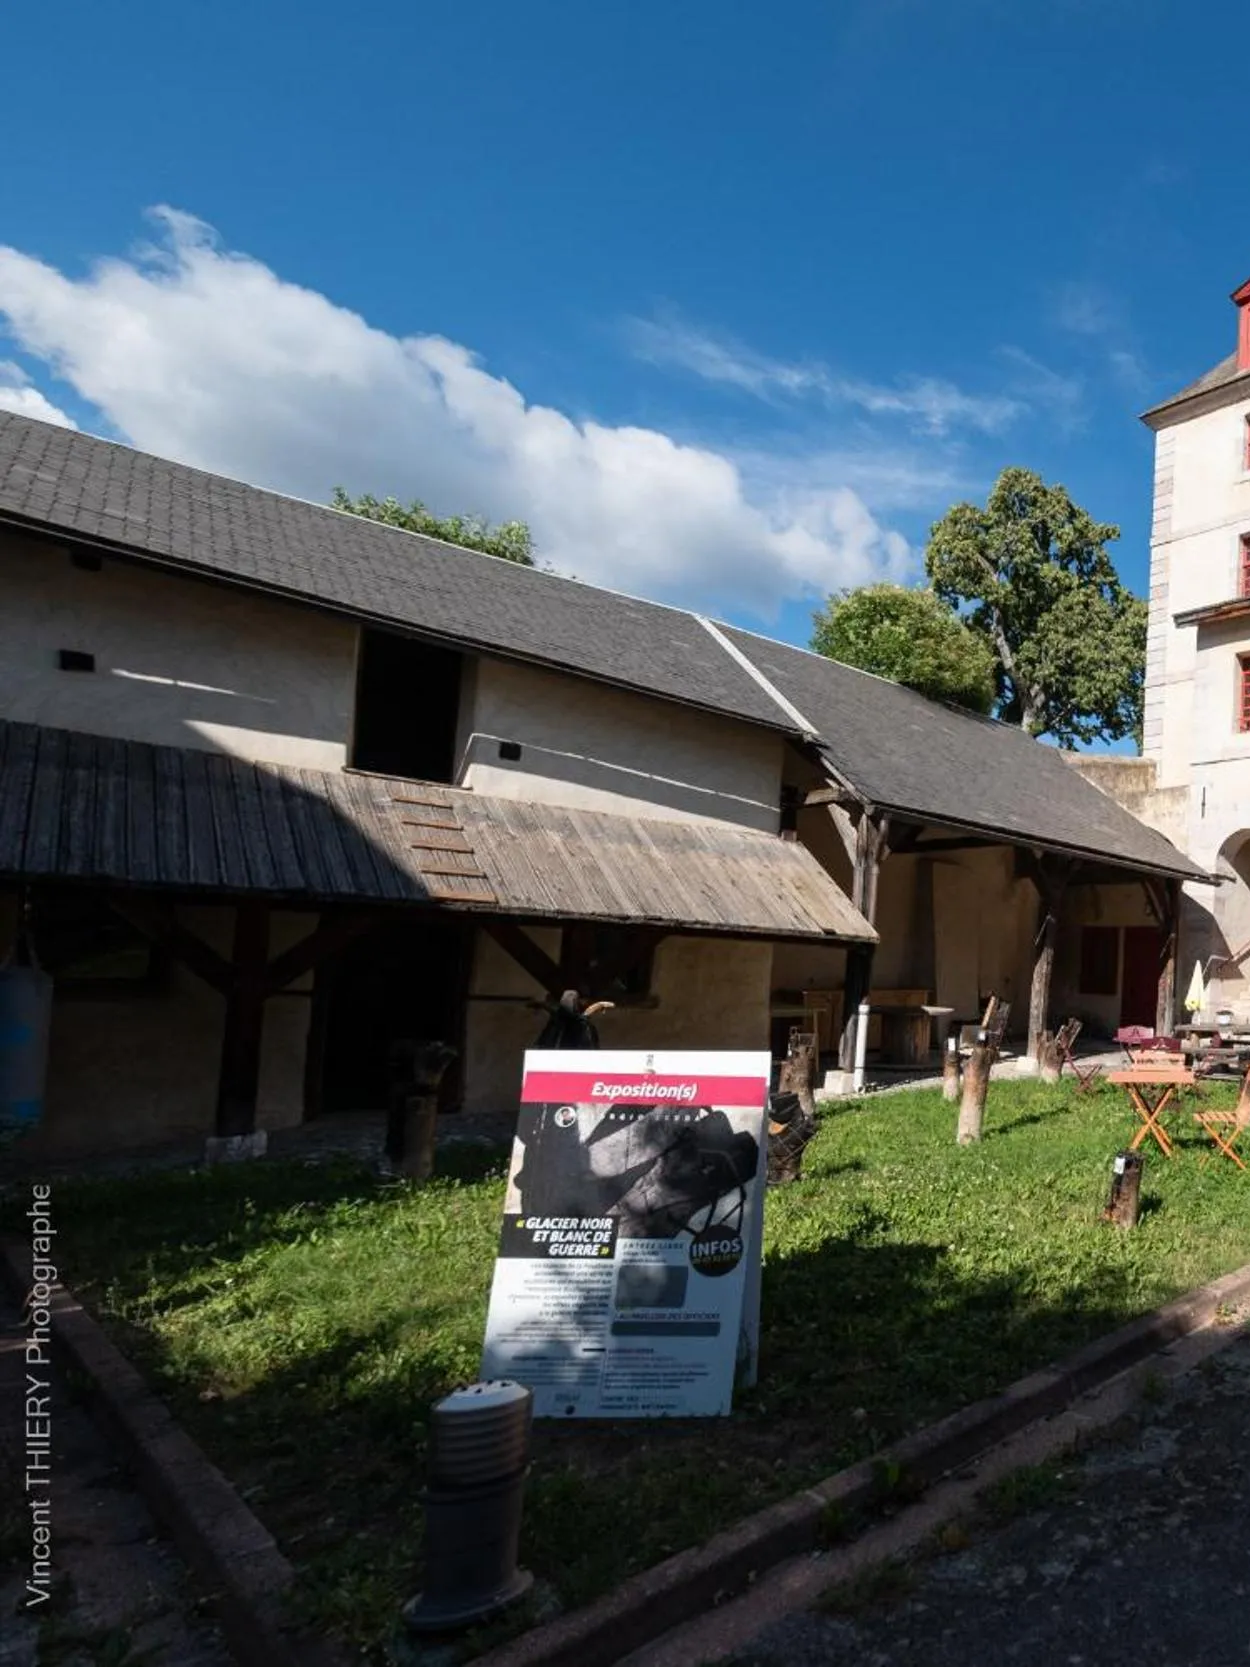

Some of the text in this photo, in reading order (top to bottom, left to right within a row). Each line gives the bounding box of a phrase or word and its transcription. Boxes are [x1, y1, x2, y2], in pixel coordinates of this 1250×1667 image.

[591, 1081, 698, 1101] Exposition(s)
[526, 1217, 578, 1229] GLACIER
[580, 1218, 613, 1229] NOIR
[532, 1231, 612, 1243] ET BLANC DE
[549, 1244, 600, 1256] GUERRE
[692, 1237, 741, 1257] INFOS
